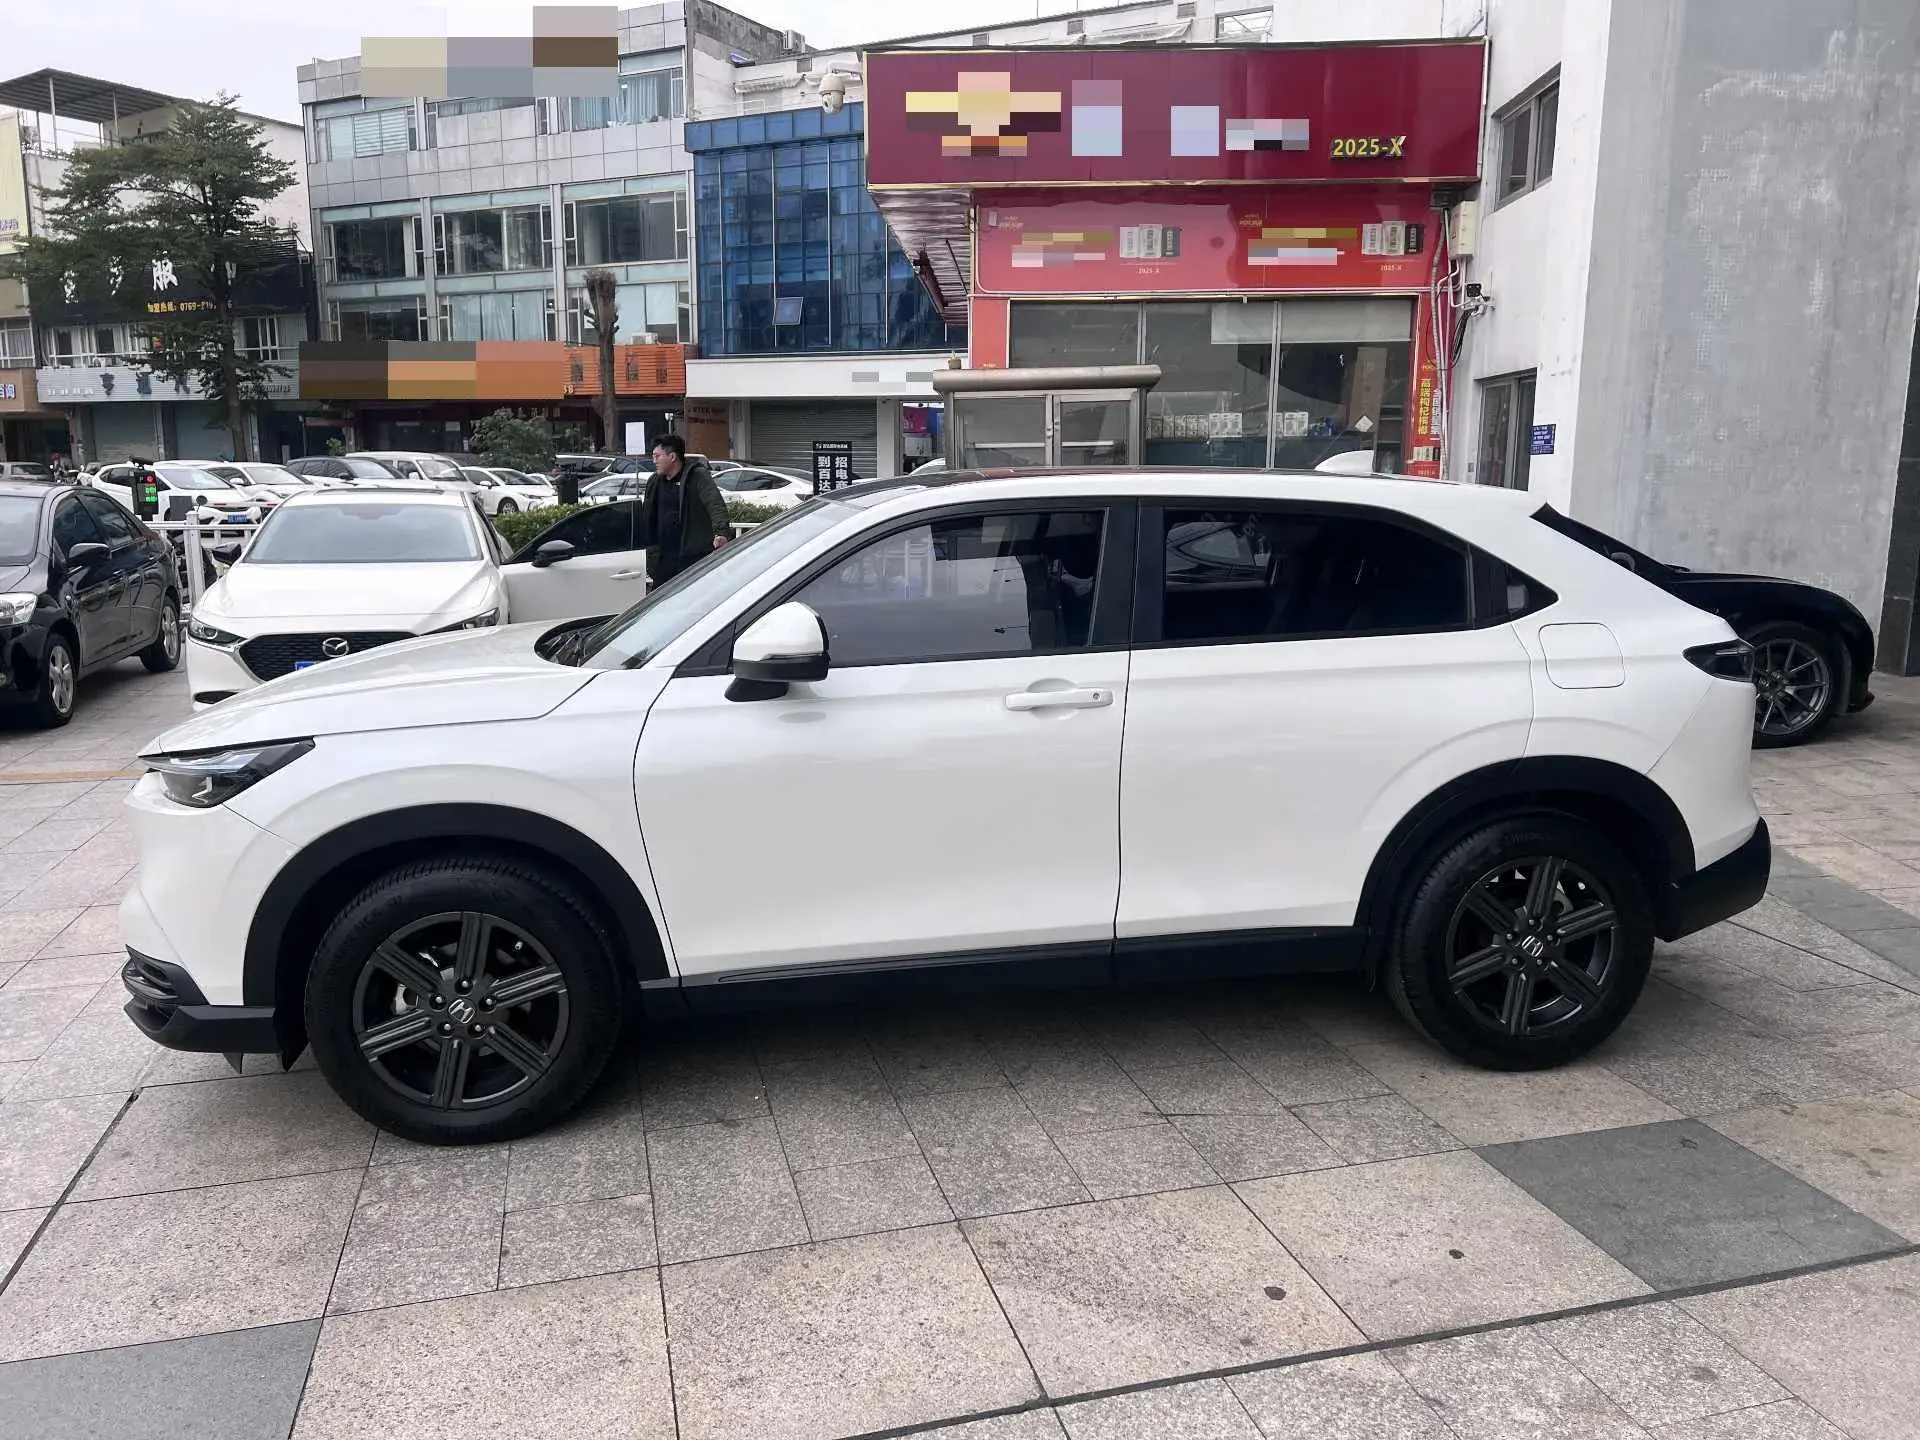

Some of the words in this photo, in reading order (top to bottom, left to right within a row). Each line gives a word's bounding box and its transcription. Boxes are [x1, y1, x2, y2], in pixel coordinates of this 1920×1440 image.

[1332, 135, 1406, 157] 2025-X
[817, 456, 831, 495] 到百达
